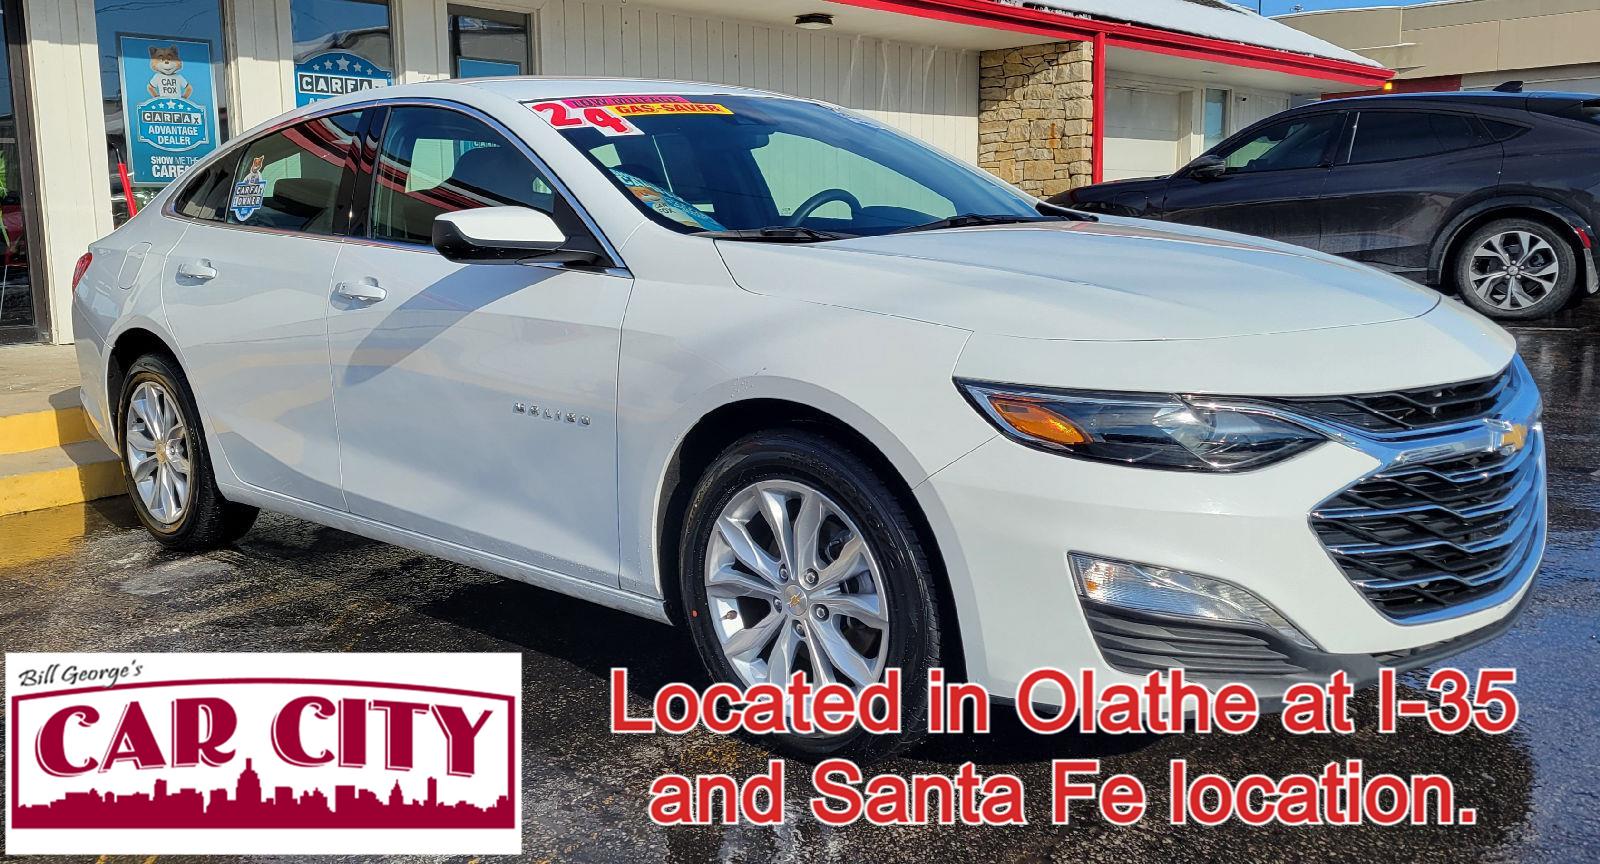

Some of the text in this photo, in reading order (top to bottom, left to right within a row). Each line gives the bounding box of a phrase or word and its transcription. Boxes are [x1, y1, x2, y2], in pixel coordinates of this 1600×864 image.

[302, 76, 386, 92] CARFA
[144, 112, 200, 125] CARFAX
[148, 125, 199, 136] ADVANTAGE
[157, 135, 191, 146] DEALER
[150, 156, 173, 165] SHOW
[174, 157, 187, 165] ME
